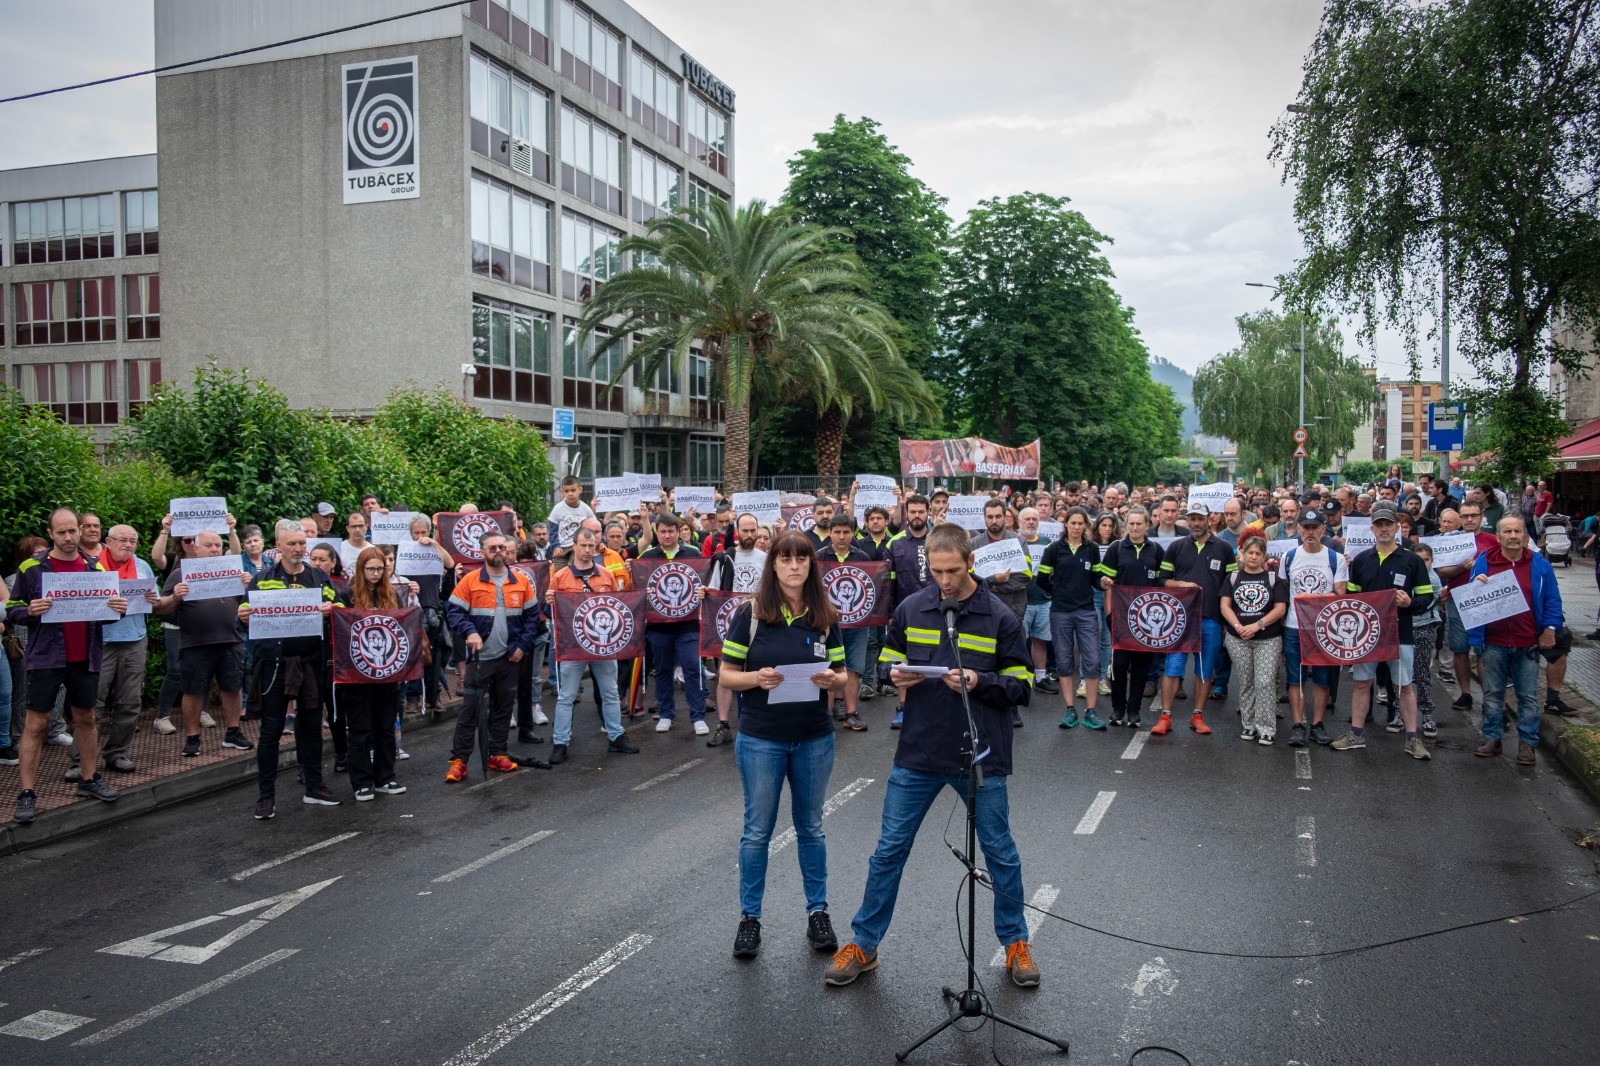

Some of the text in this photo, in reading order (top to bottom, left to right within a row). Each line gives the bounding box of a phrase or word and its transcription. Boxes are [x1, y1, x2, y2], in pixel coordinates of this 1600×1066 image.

[680, 53, 736, 113] TUBACEX
[391, 186, 415, 194] GROUP
[597, 486, 640, 496] ABSOLUZIOA
[172, 509, 227, 518] ABSOLUZIOA
[734, 502, 779, 511] ABSOLUZIOA
[974, 548, 1022, 567] ABSOLUZIOA
[1433, 542, 1475, 554] SOLUZIOA
[184, 569, 243, 580] ABSOLUZIOA
[649, 563, 698, 584] TUBACEX
[45, 588, 118, 598] ABSOLUZIOA
[648, 587, 668, 615] SALBA
[1131, 593, 1182, 612] TUBACEX
[1459, 584, 1520, 609] ABSOLUZIOA
[253, 605, 320, 615] ABSOLUZIOA
[576, 597, 628, 618] TUBACEX
[841, 588, 875, 623] DEZAGUN
[1317, 600, 1375, 623] TUBACEX
[352, 616, 401, 637] TUBACEX
[599, 617, 633, 656] DEZAGUN
[1129, 614, 1148, 644] SALBA
[1151, 614, 1185, 647] DEZAGUN
[574, 621, 596, 655] SALBA
[1317, 626, 1341, 657] SALBA
[1344, 620, 1379, 659] DEZAGUN
[351, 640, 373, 676] SALBA
[375, 636, 408, 678] DEZAGUN
